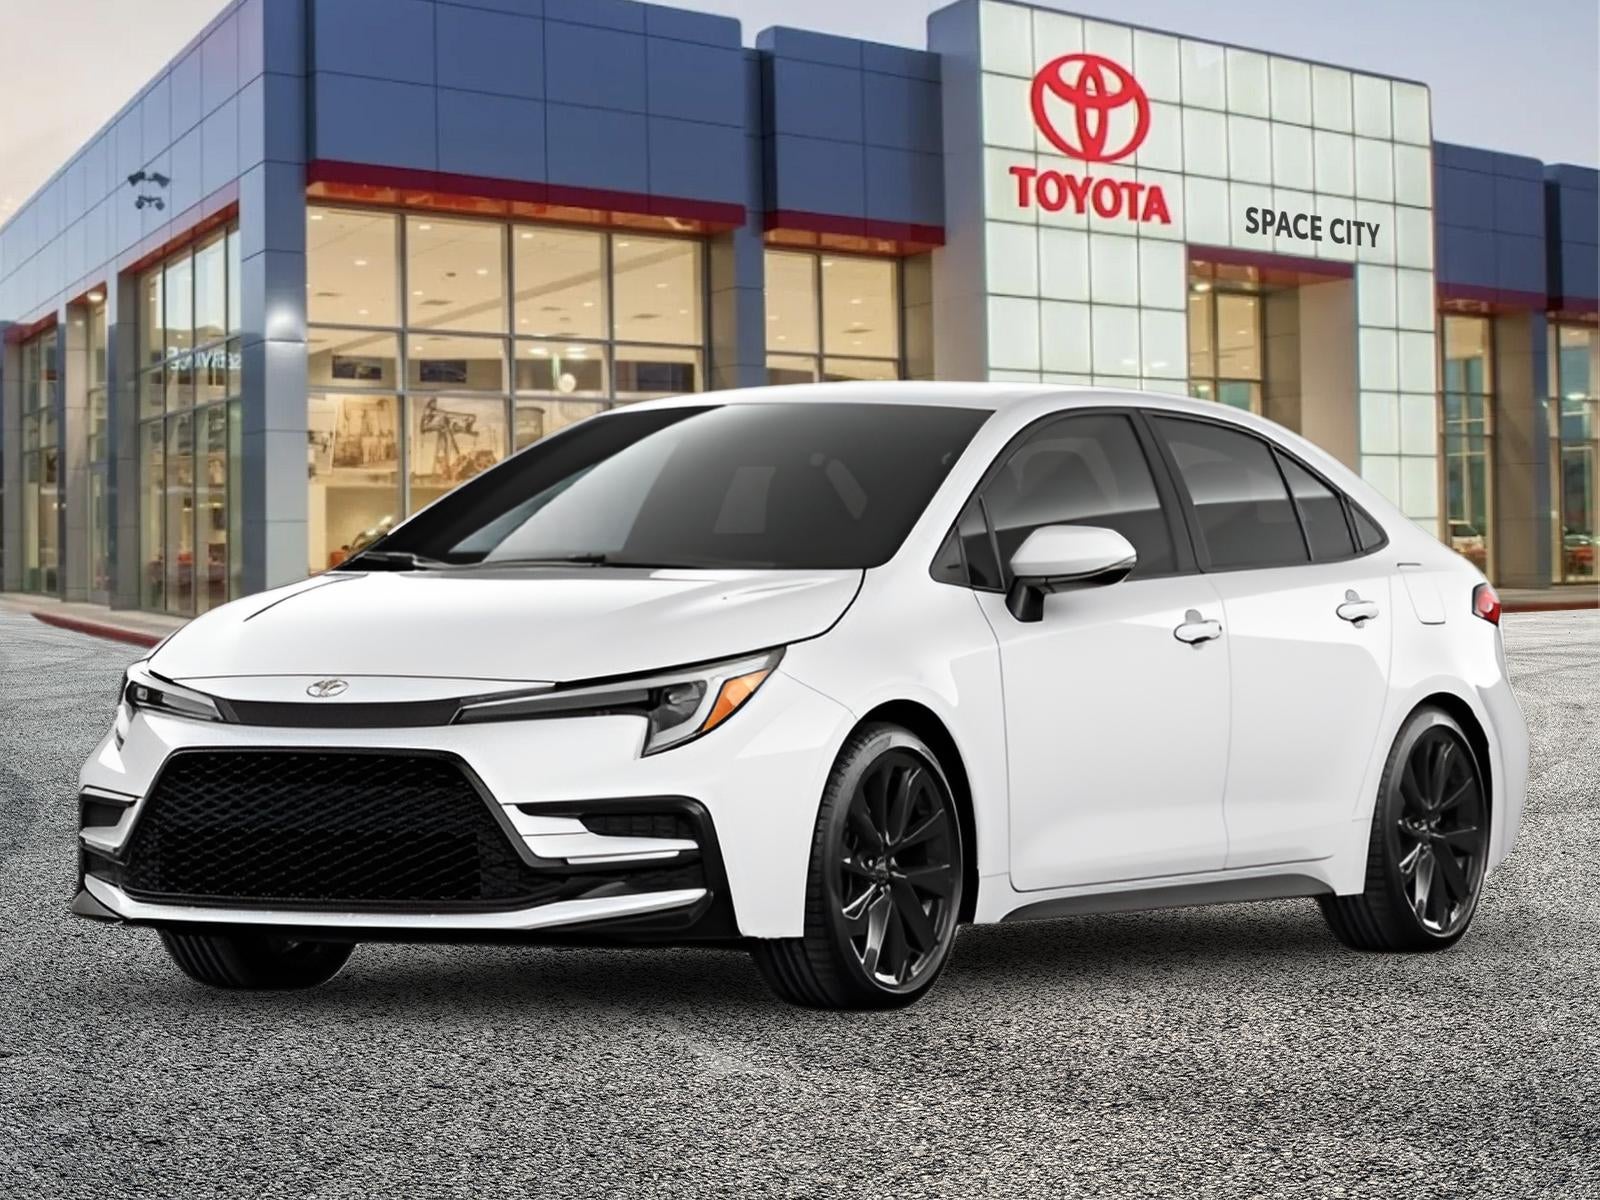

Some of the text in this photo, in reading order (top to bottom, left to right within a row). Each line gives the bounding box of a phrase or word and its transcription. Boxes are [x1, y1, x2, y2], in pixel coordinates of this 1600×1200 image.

[1010, 166, 1171, 224] TOYOTA
[1245, 206, 1380, 248] SPACE CITY
